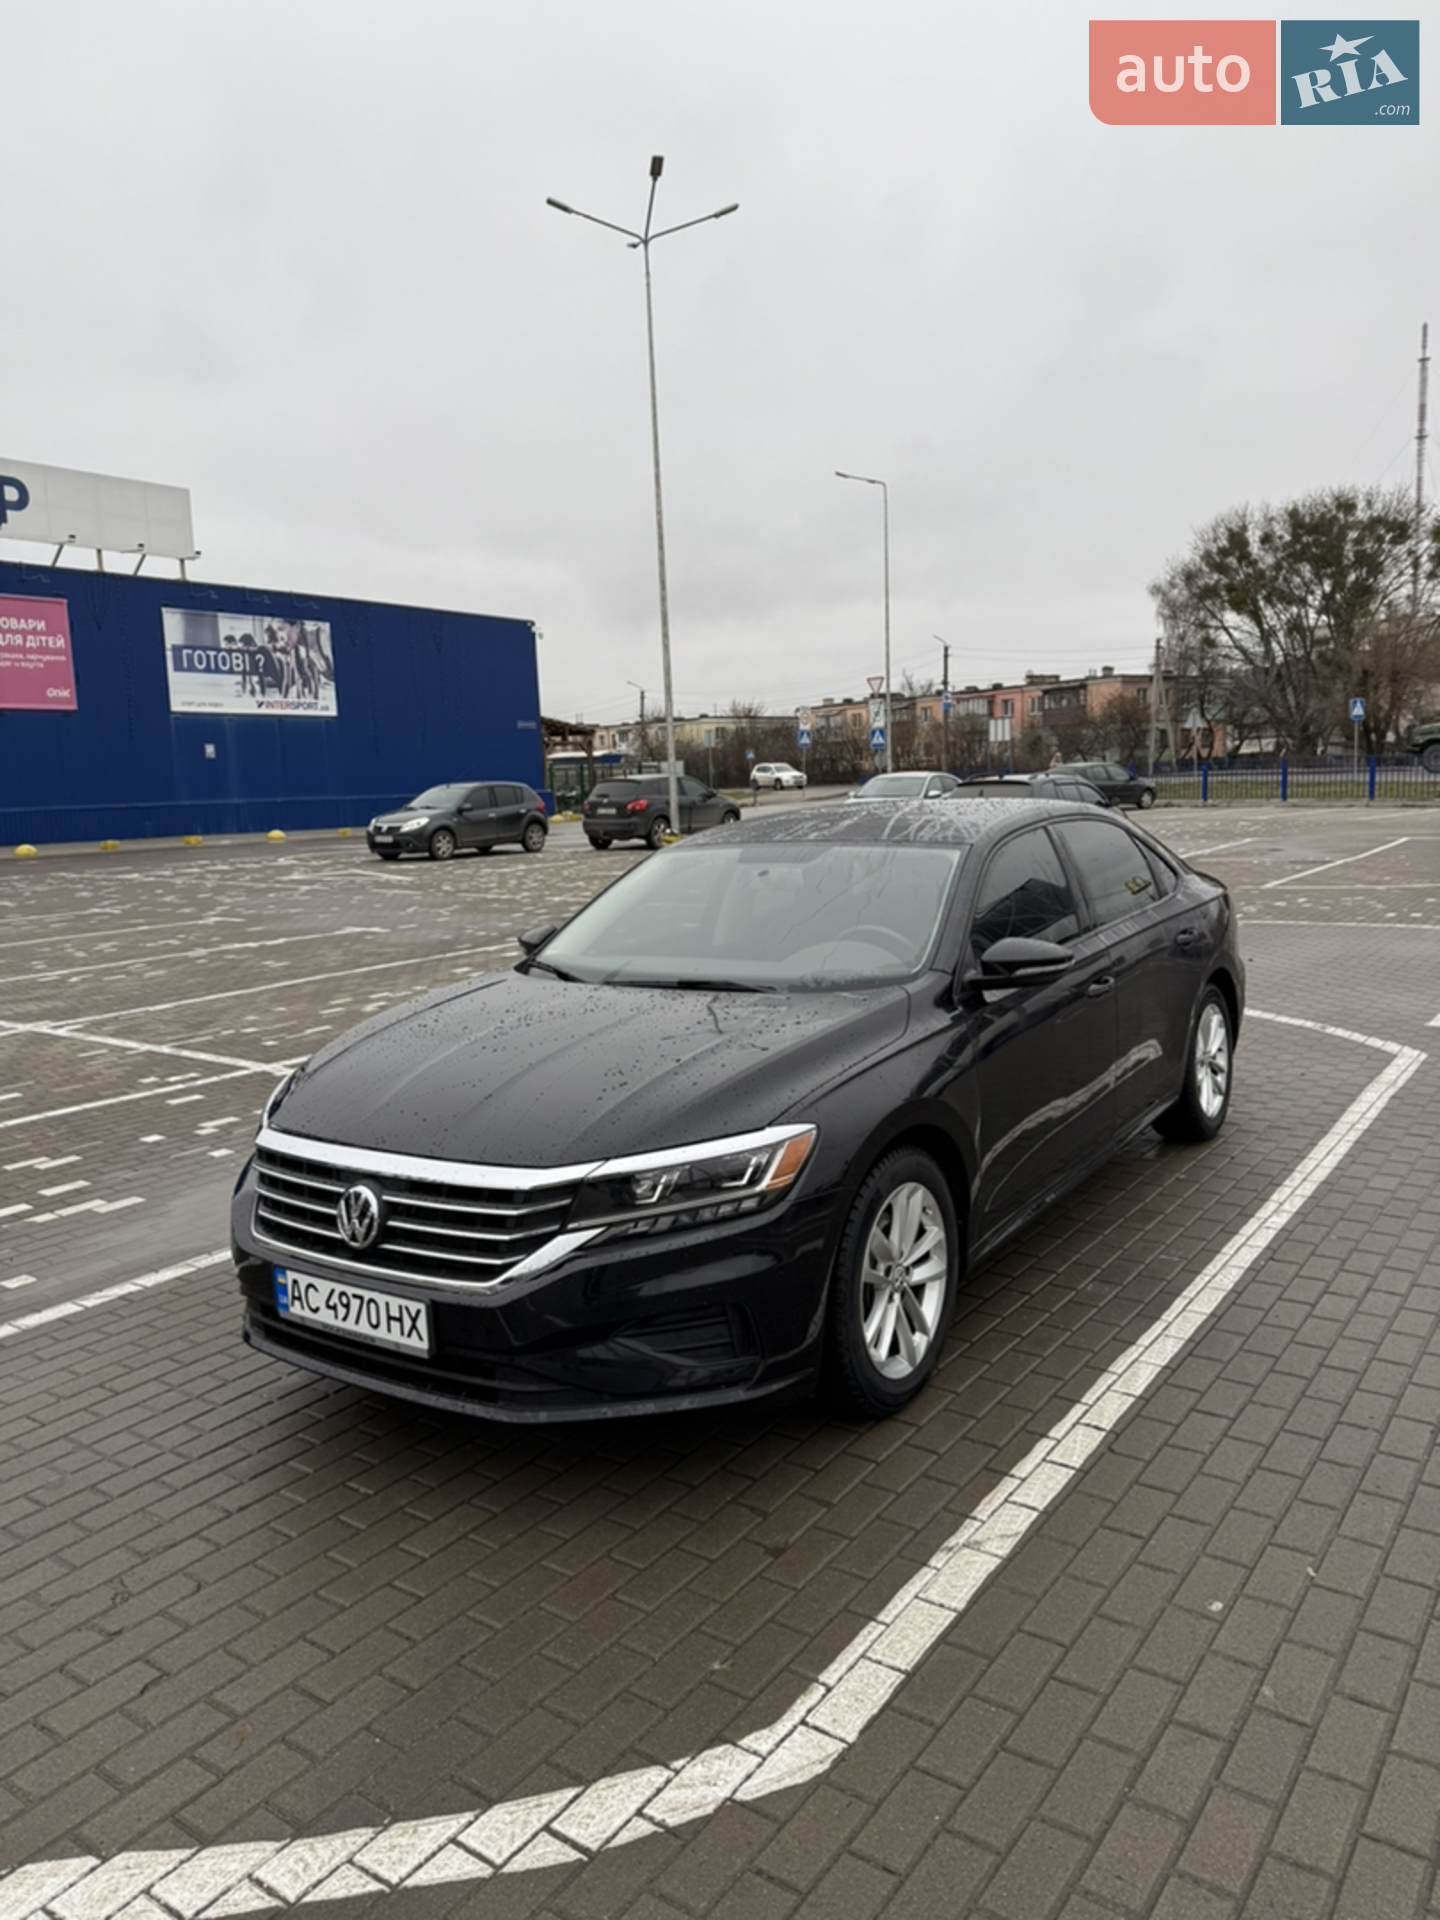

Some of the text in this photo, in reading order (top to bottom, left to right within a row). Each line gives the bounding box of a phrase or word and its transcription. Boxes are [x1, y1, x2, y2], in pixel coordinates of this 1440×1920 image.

[26, 634, 65, 649] ДІТЕЙ
[181, 648, 266, 673] ГОТОВІ ?
[290, 1278, 425, 1342] AC 4970 HX
